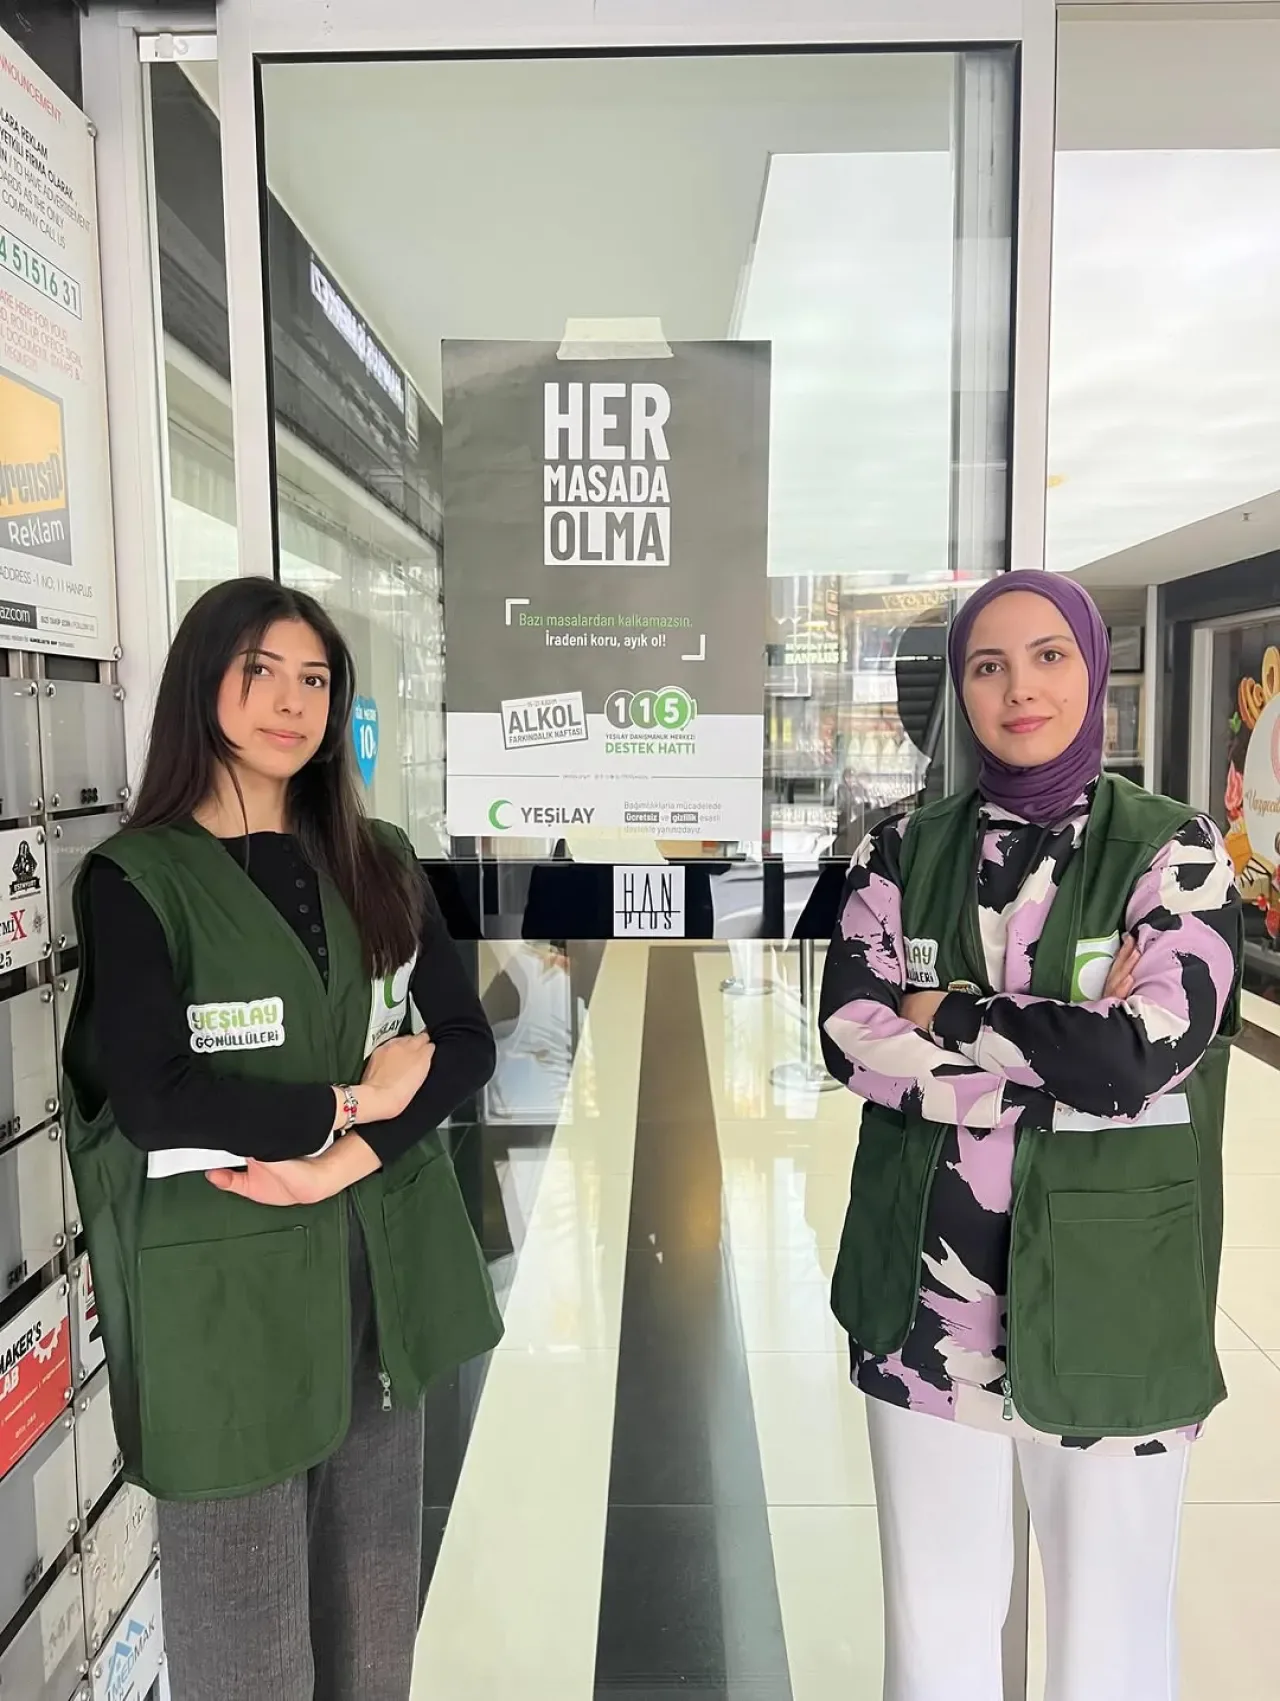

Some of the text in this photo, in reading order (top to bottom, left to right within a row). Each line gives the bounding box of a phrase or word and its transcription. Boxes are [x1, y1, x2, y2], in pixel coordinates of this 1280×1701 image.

[544, 382, 671, 461] HER
[544, 465, 670, 503] MASADA
[7, 516, 65, 547] Reklam
[550, 510, 665, 562] OLMA
[519, 613, 693, 628] Bazı masalardan kalkamazsın.
[545, 630, 667, 649] İradeni koru, ayık ol!
[508, 704, 582, 733] ALKOL
[359, 724, 374, 760] 10
[605, 742, 696, 754] DESTEK HATTI
[623, 873, 672, 913] HAN
[623, 912, 672, 930] PLUS
